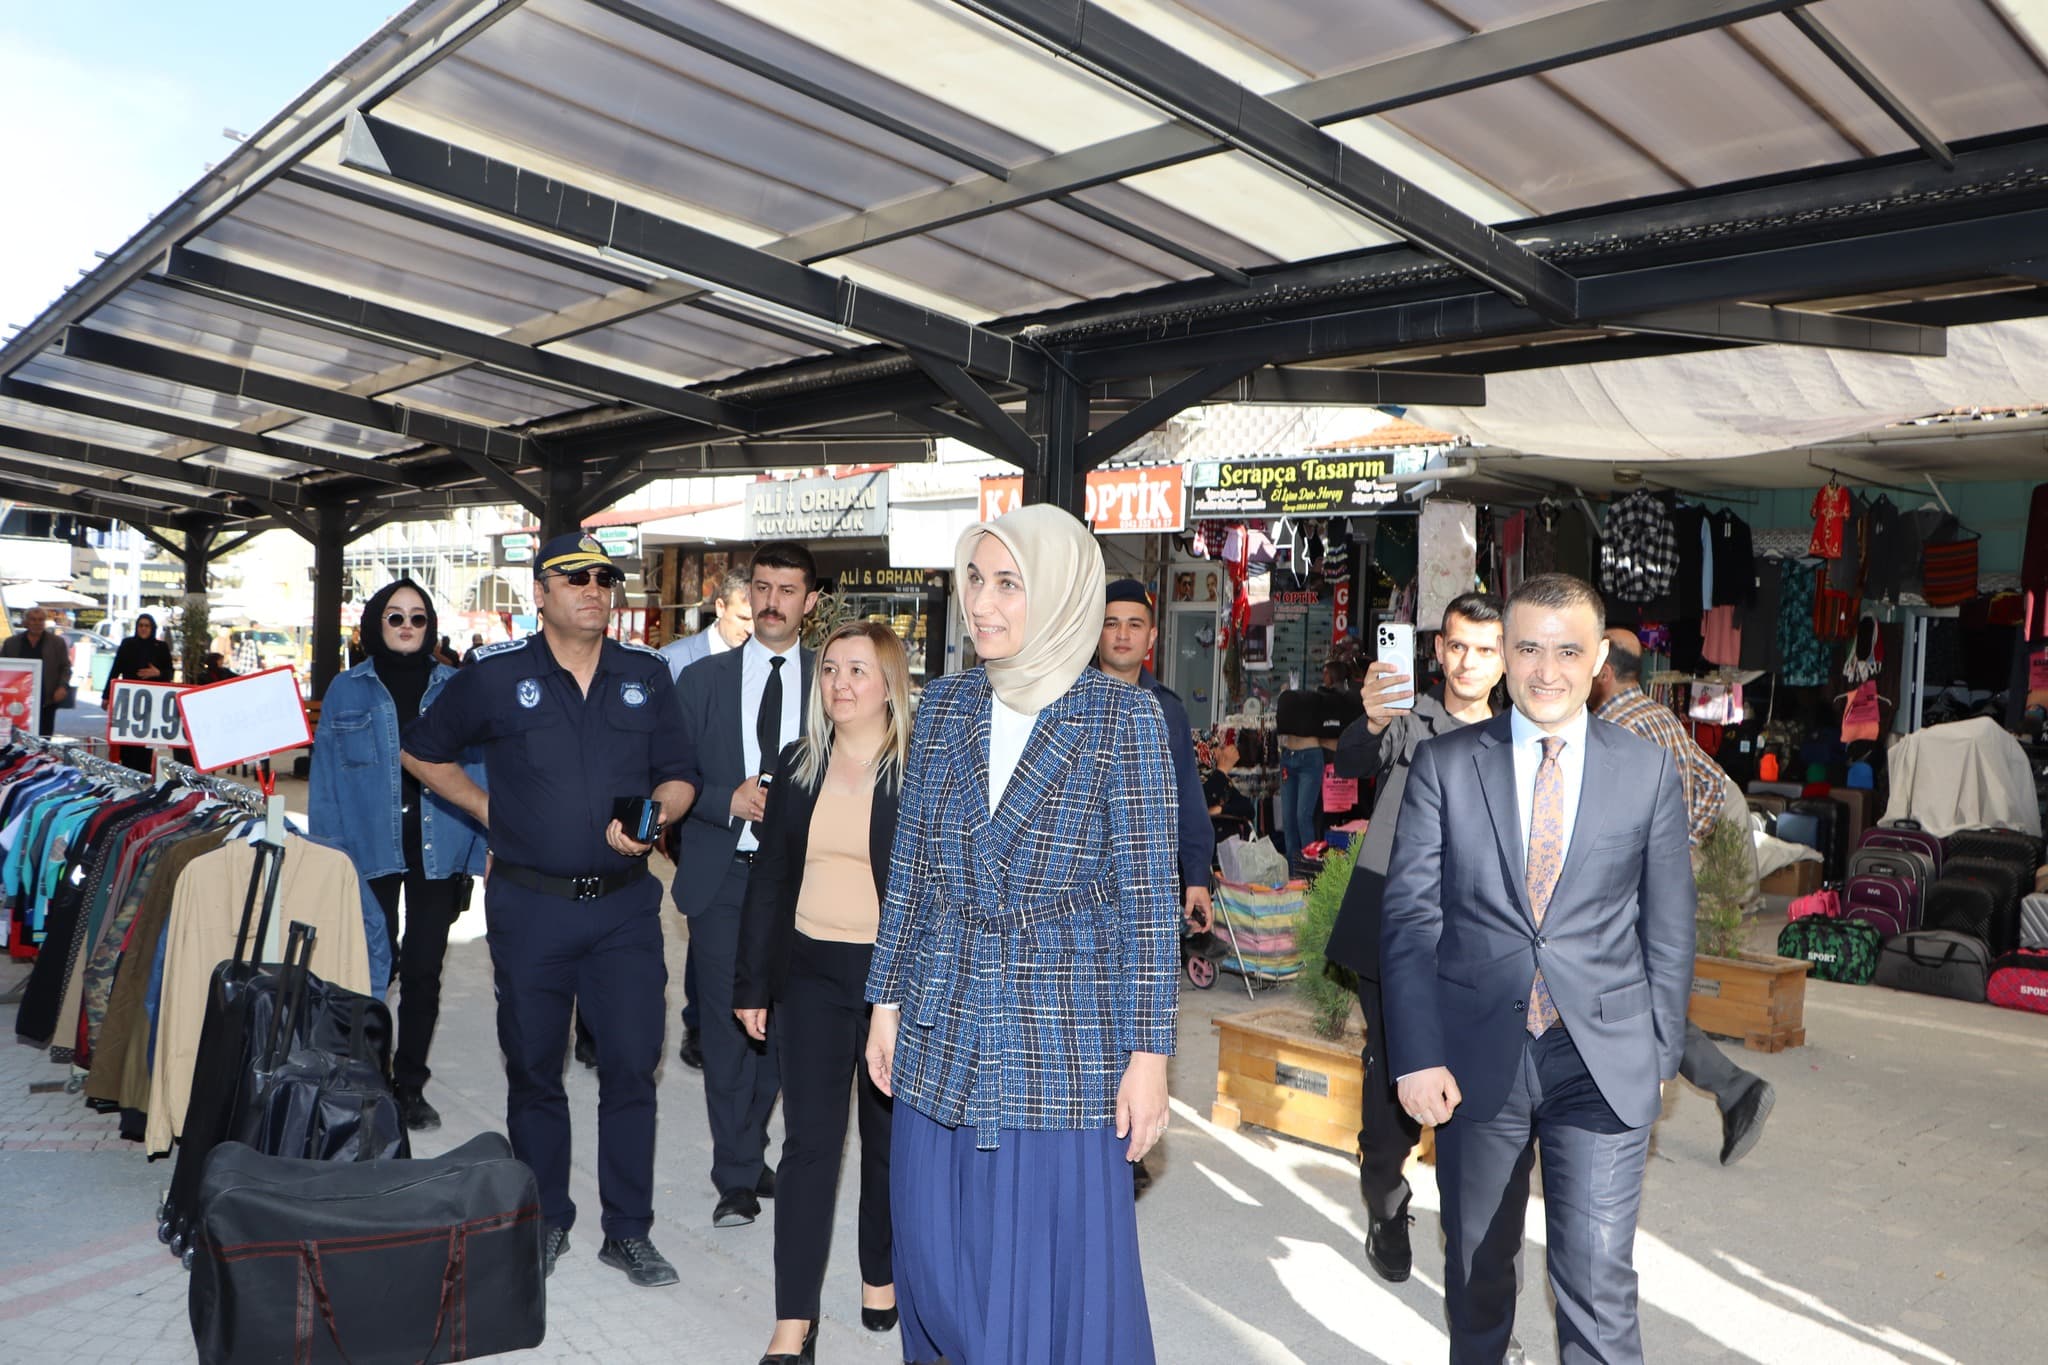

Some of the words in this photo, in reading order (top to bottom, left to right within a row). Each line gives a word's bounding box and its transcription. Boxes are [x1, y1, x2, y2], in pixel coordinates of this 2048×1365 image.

[1220, 462, 1297, 490] Serapça
[1301, 458, 1386, 484] Tasarım
[752, 487, 783, 515] ALİ
[800, 486, 877, 513] ORHAN
[756, 515, 865, 535] KUYUMCULUK
[839, 568, 859, 585] ALİ
[863, 570, 873, 585] &
[876, 569, 925, 585] ORHAN
[1283, 588, 1320, 605] OPTİK
[112, 687, 188, 741] 49.9
[1807, 950, 1837, 964] SPORT
[2020, 983, 2048, 998] SPOR
